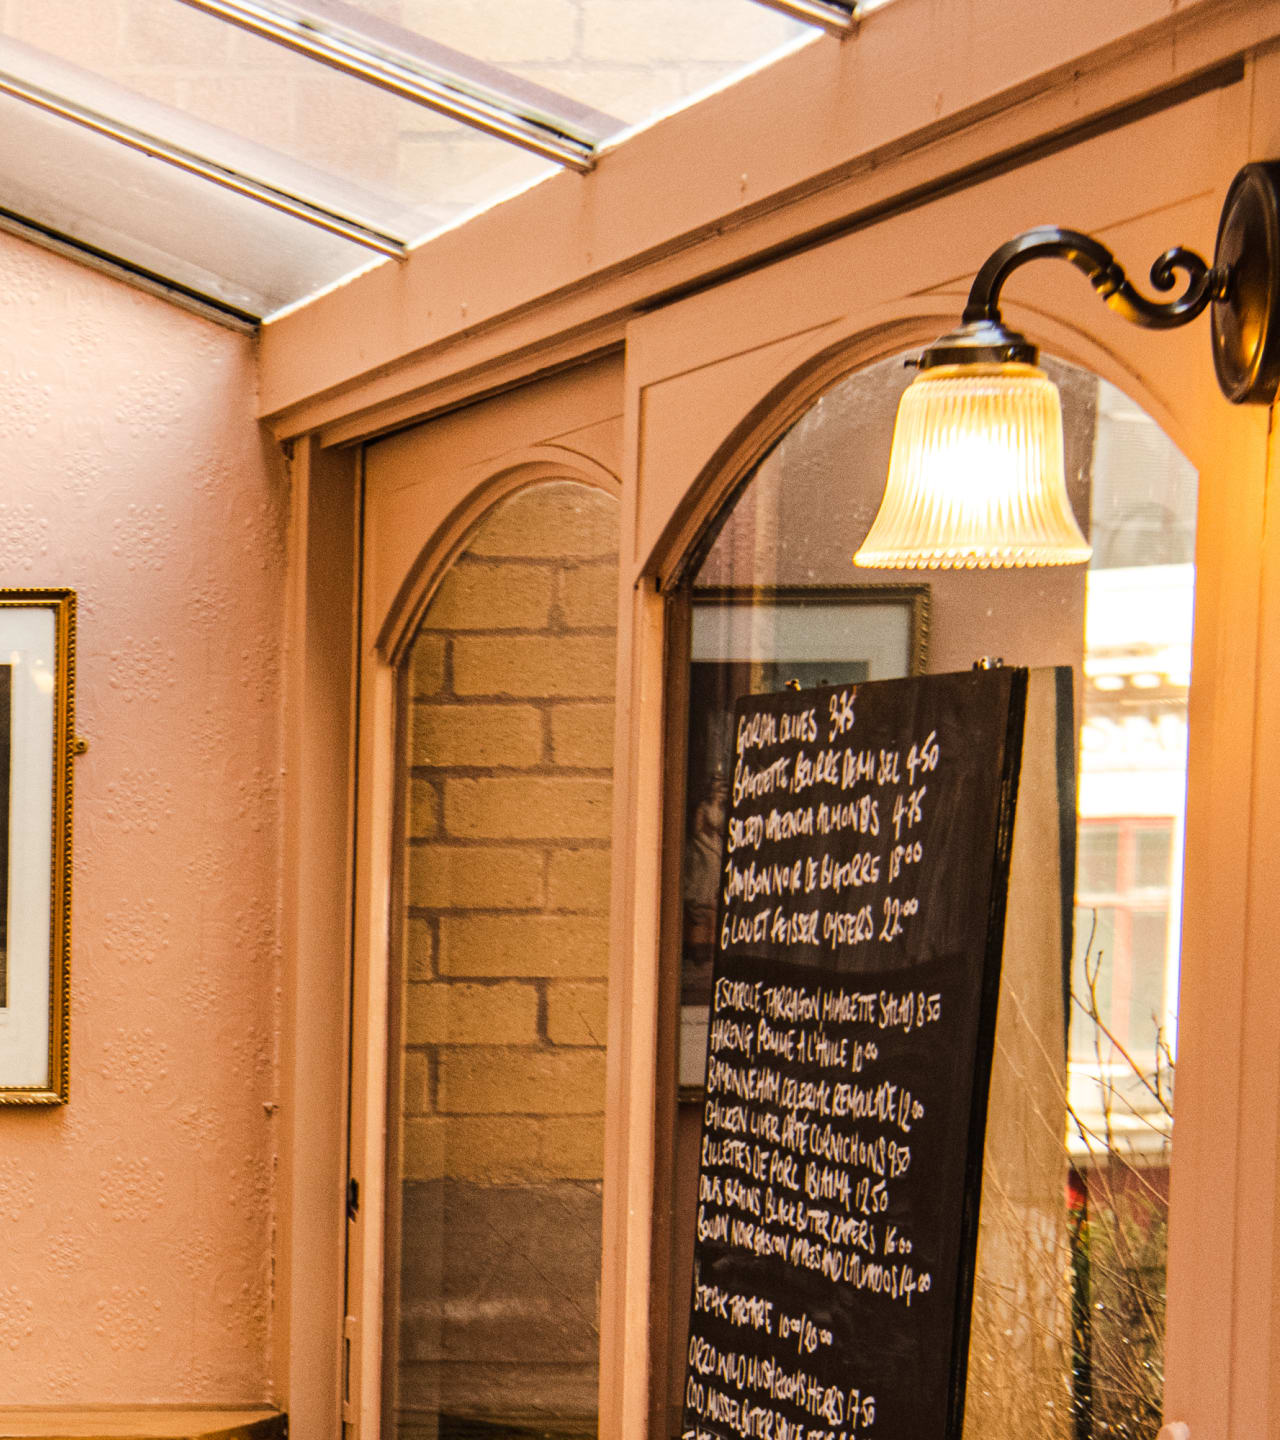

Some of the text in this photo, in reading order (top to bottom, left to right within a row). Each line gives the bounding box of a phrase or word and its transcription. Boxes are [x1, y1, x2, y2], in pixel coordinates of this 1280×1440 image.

[841, 747, 876, 791] DEMI
[877, 748, 900, 786] SEL
[817, 795, 880, 836] ALMONDS
[804, 856, 819, 894] DE
[720, 912, 730, 950] 6
[823, 904, 874, 950] OYSTERS
[705, 1097, 748, 1134] CHICKEN
[752, 1144, 770, 1182] DE
